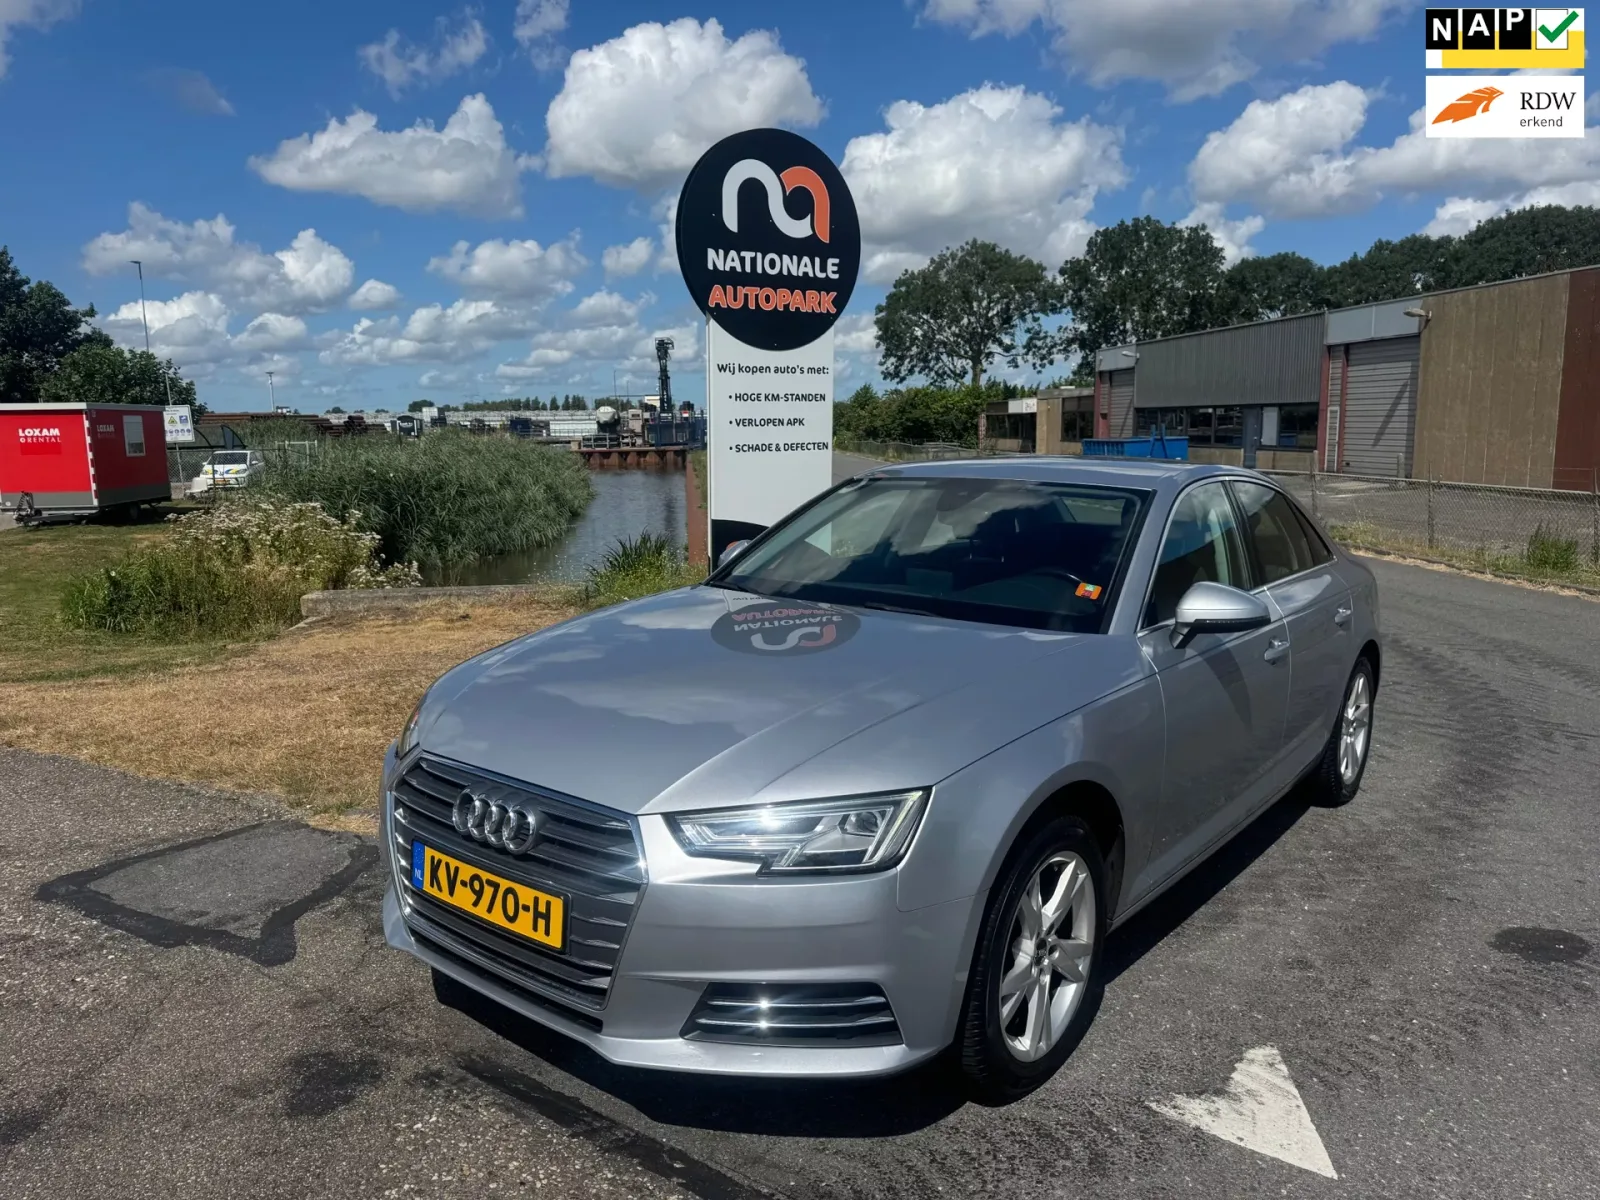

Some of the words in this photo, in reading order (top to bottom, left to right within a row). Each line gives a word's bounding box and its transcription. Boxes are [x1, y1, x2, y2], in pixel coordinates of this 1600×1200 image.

[707, 247, 840, 280] NATIONALE
[708, 284, 837, 314] AUTOPARK
[717, 363, 736, 376] Wij
[738, 363, 771, 376] kopen
[773, 365, 805, 375] auto's
[807, 366, 829, 375] met:
[734, 393, 762, 402] HOGE
[764, 393, 826, 402] KM-STANDEN
[734, 418, 785, 427] VERLOPEN
[786, 418, 805, 427] APK
[18, 428, 60, 437] LOXAM
[735, 443, 773, 453] SCHADE
[774, 443, 782, 452] &
[783, 442, 829, 452] DEFECTEN
[414, 868, 423, 881] NL
[429, 855, 552, 937] KV-970-H
